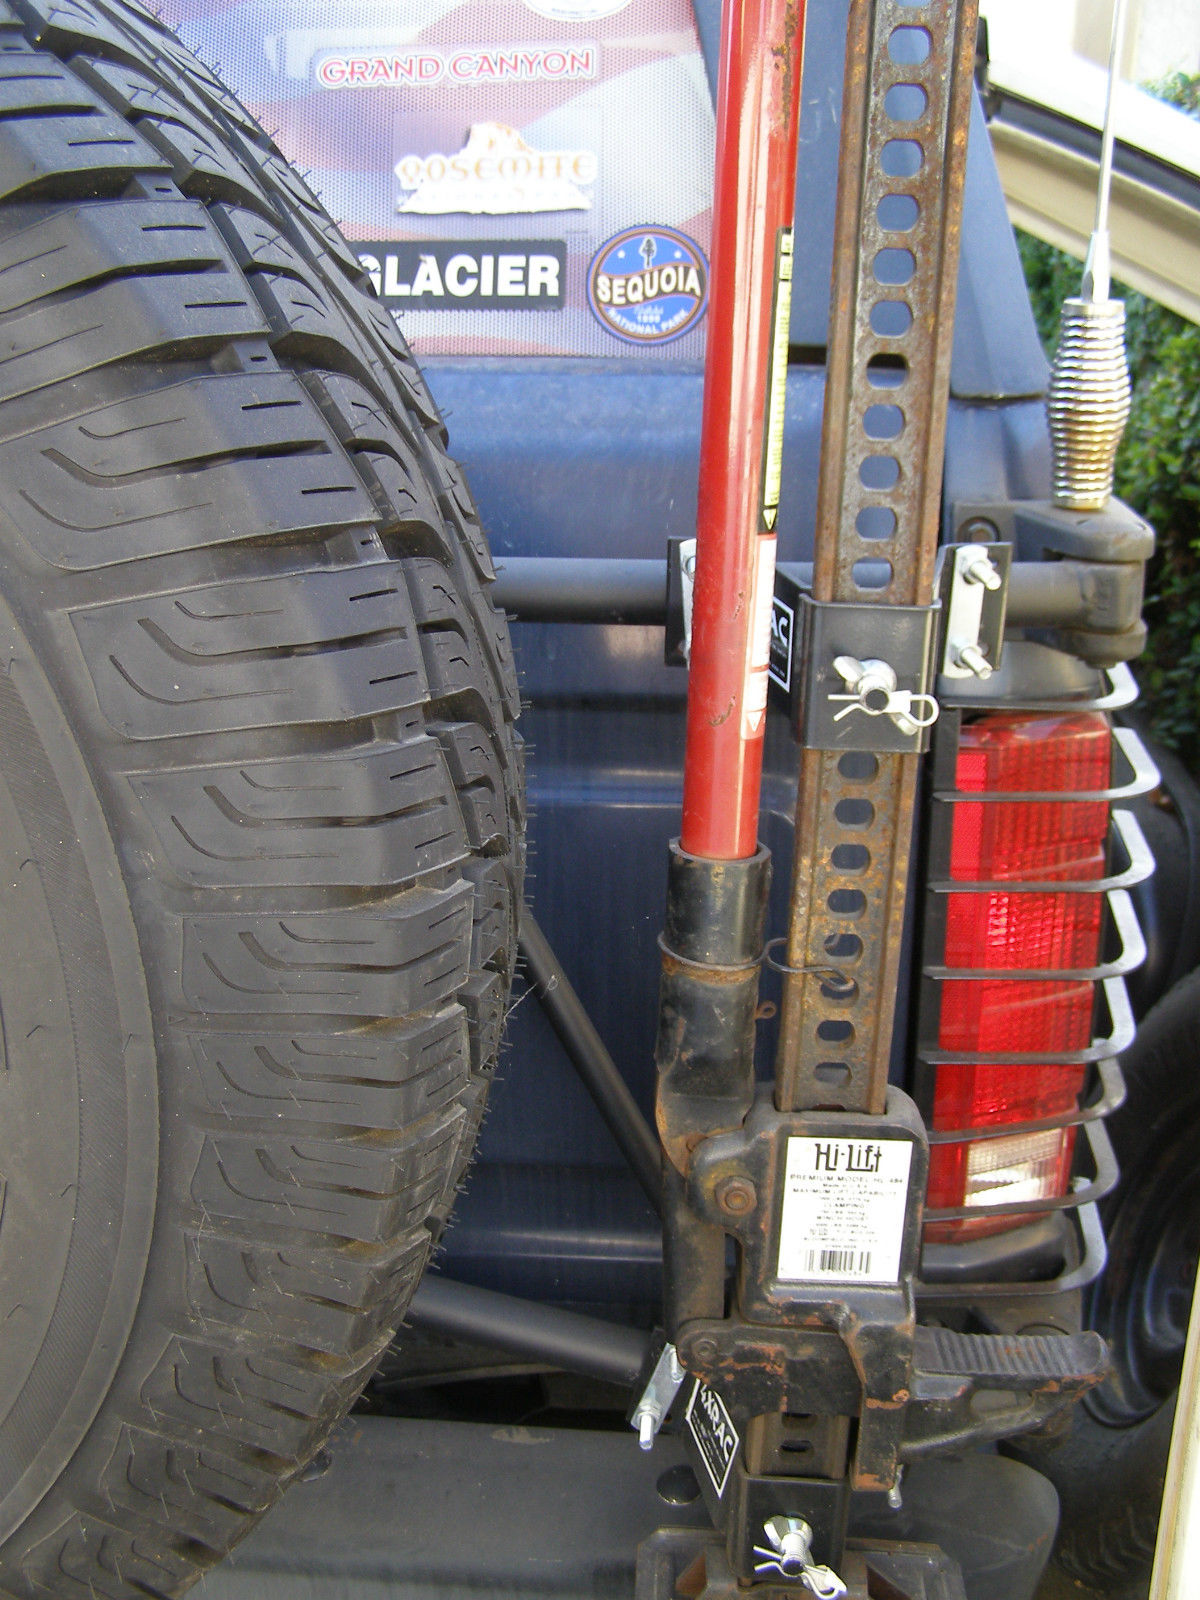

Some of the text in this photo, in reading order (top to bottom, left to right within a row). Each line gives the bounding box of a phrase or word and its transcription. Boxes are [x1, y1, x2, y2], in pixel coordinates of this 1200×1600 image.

[321, 50, 591, 84] GRAND CANYON
[401, 154, 594, 183] YOSEMITE
[596, 265, 702, 305] SEQUOIA
[607, 307, 690, 335] NATIONAL PARK
